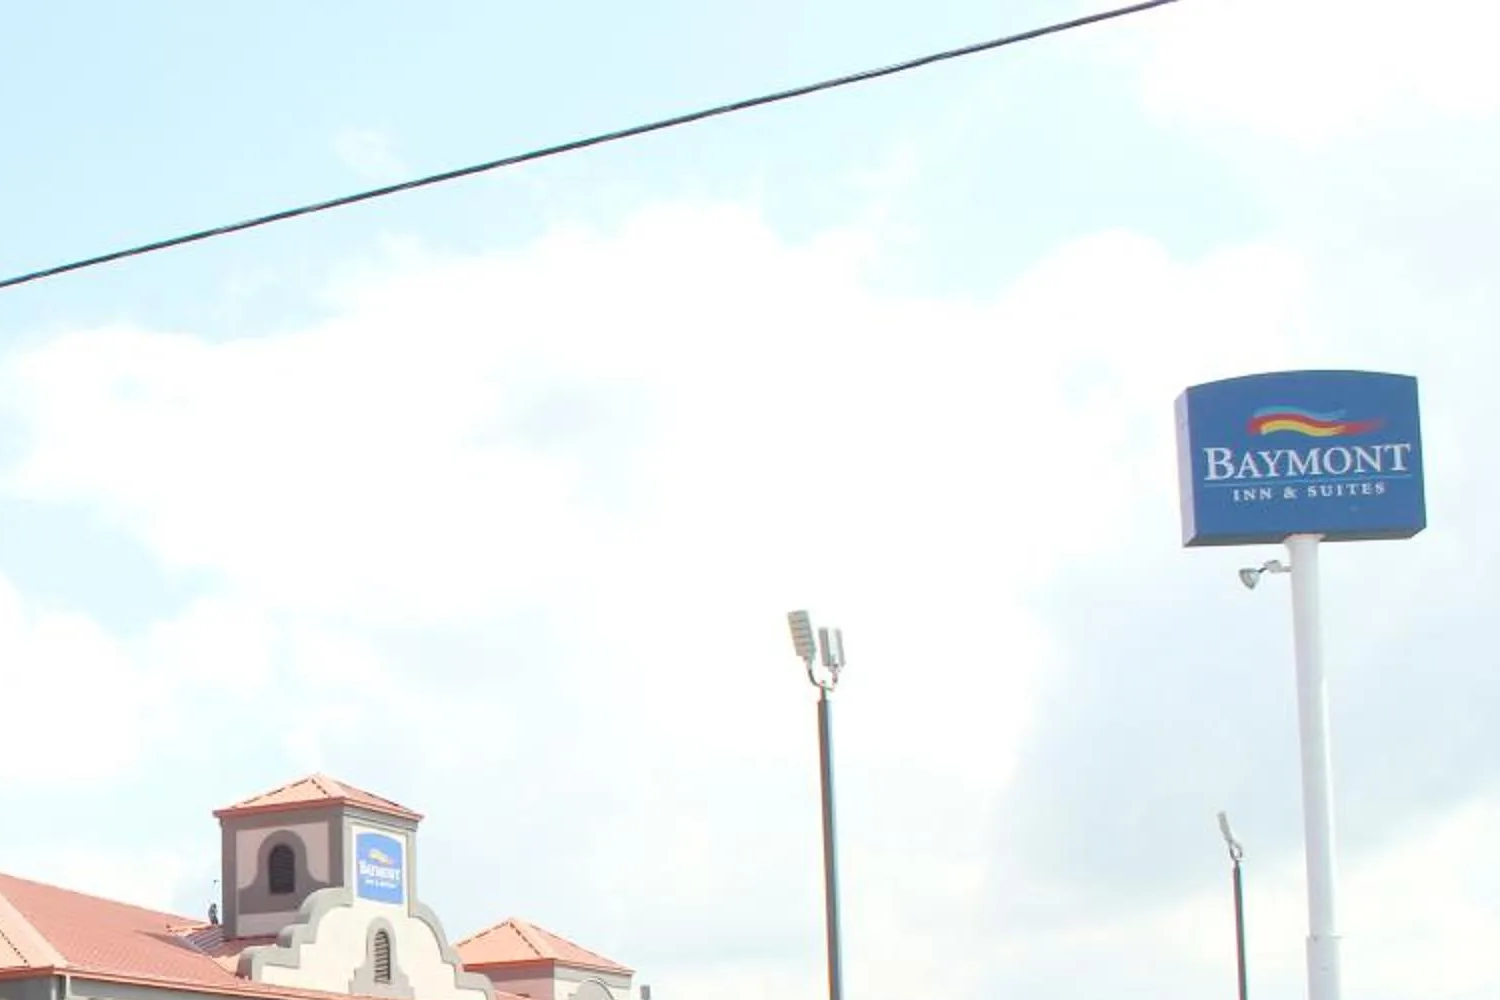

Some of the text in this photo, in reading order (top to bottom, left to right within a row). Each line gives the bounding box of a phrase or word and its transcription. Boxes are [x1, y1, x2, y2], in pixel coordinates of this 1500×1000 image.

[1203, 443, 1412, 481] BAYMONT
[1233, 481, 1385, 502] INN & SUITES
